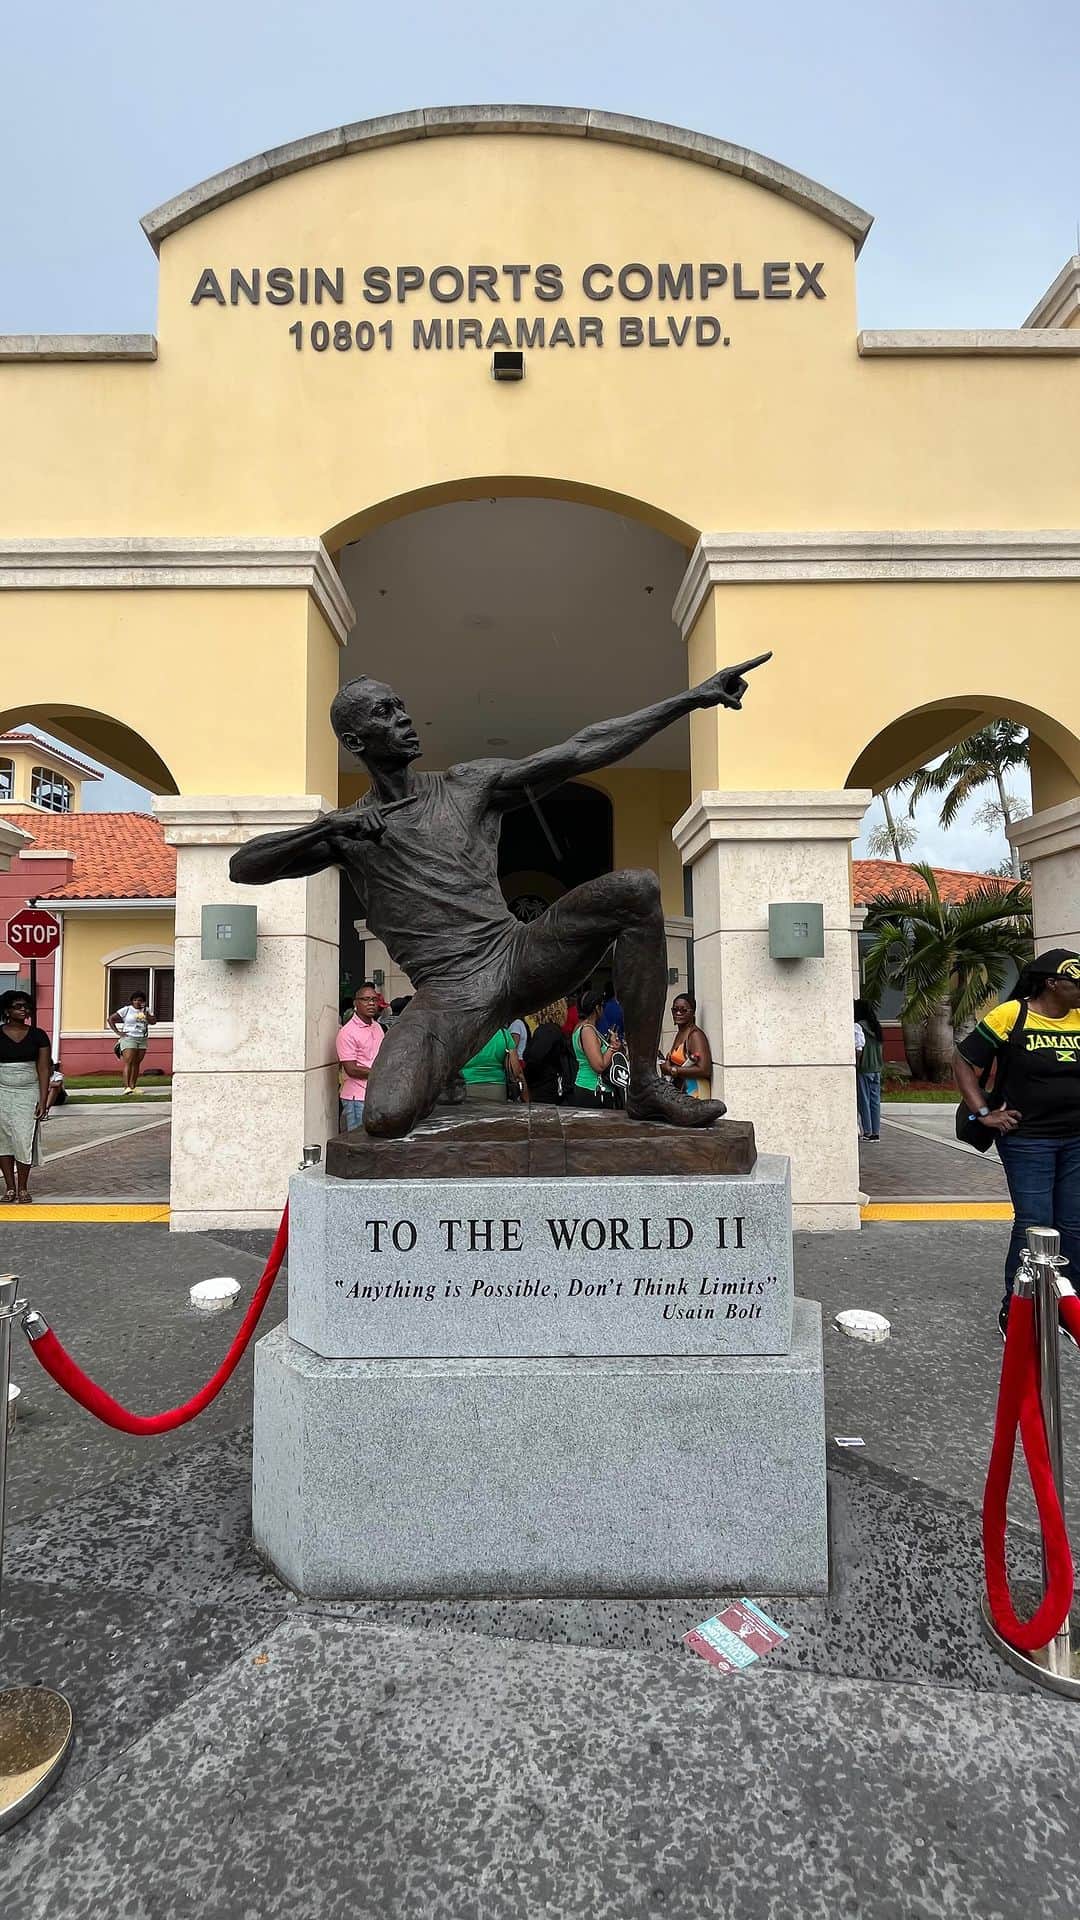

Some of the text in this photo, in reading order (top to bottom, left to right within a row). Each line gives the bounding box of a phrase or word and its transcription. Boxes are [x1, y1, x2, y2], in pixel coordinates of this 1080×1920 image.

[190, 261, 827, 306] ANSIN SPORTS COMPLEX
[289, 315, 731, 352] 10801 MIRAMAR BLVD.
[11, 924, 58, 944] STOP
[365, 1216, 747, 1253] TO THE WORLD II
[444, 1279, 463, 1298] is
[470, 1278, 559, 1299] Possible,
[633, 1276, 690, 1297] Think
[662, 1303, 763, 1320] Usain Bolt
